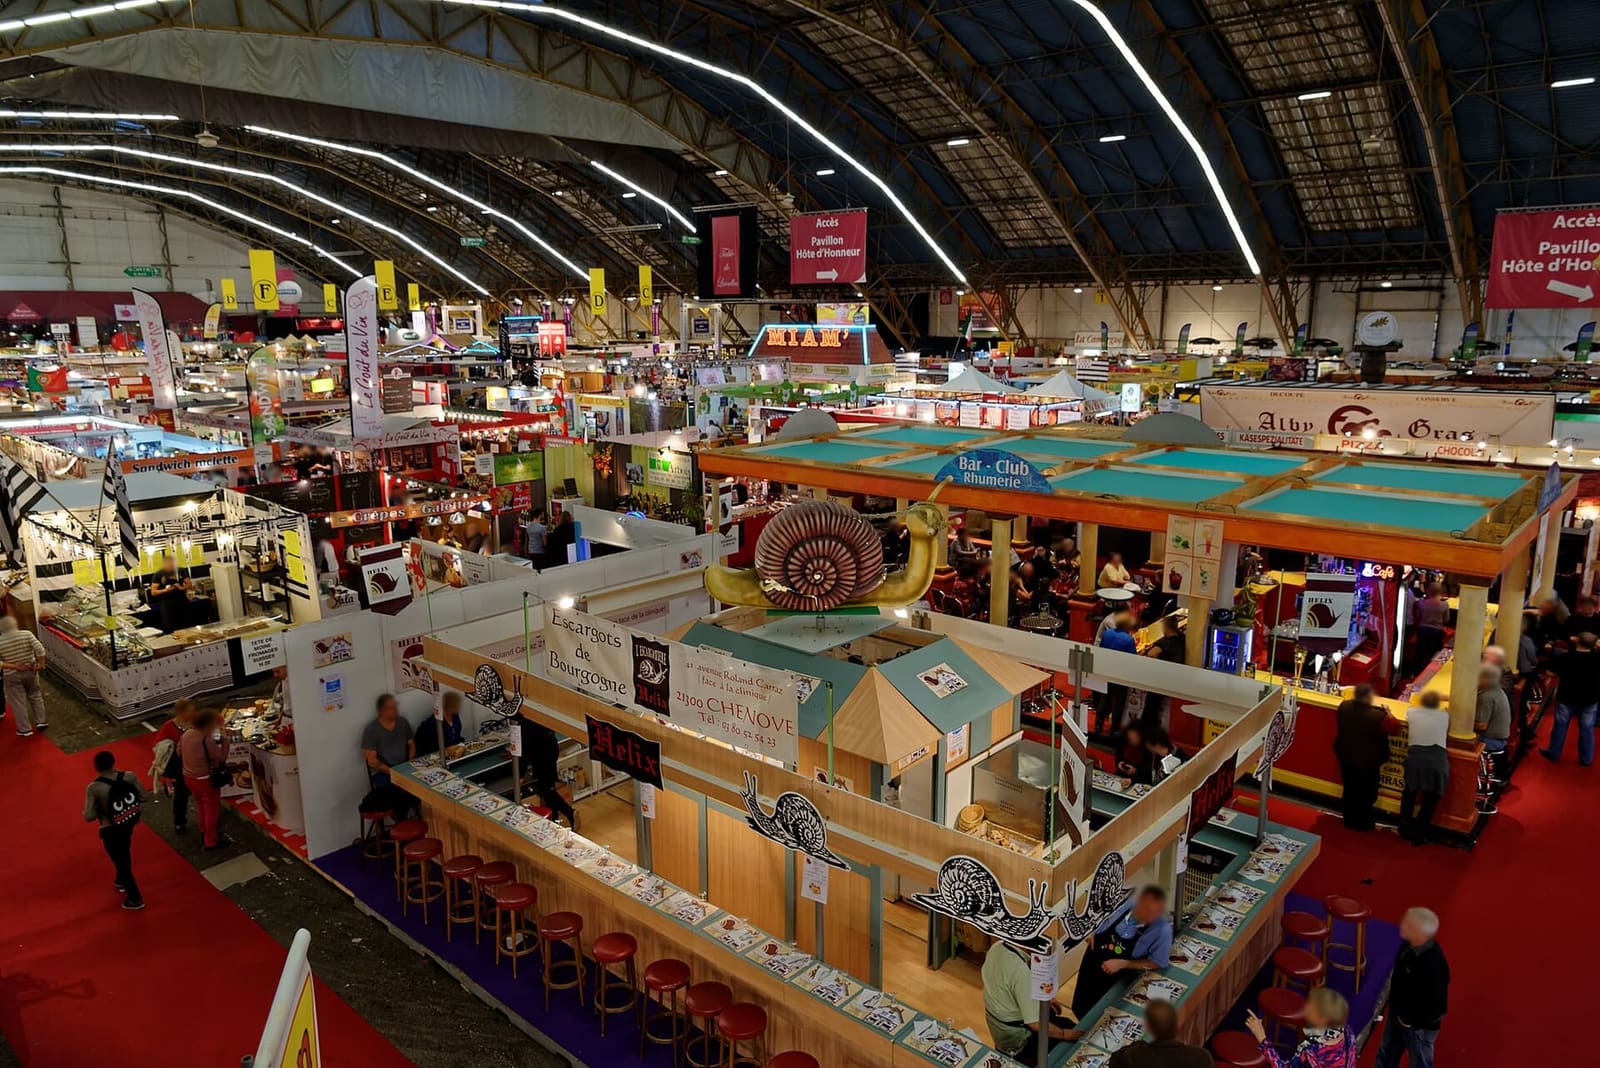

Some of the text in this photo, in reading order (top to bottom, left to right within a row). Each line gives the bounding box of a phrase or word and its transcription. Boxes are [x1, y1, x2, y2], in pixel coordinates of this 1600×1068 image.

[816, 217, 839, 228] Accès
[811, 235, 844, 246] Pavillon
[1538, 239, 1600, 255] Pavillo
[796, 248, 861, 259] Hôte d'Honneur
[1501, 259, 1544, 273] Hôte
[259, 283, 271, 299] F
[383, 288, 393, 301] E
[642, 288, 649, 299] C
[594, 295, 604, 306] D
[352, 315, 368, 338] Vin
[767, 328, 849, 347] MIAM'
[355, 338, 371, 357] du
[259, 356, 277, 436] SANDWICH
[1258, 411, 1476, 441] Alby Gras
[1341, 439, 1385, 450] PIZZA
[959, 456, 982, 471] Bar
[995, 459, 1030, 476] Club
[963, 471, 1022, 488] Rhumerie
[367, 566, 389, 576] HELIX
[552, 608, 622, 648] Escargots
[398, 636, 422, 648] HELI
[575, 643, 591, 662] de
[549, 650, 627, 695] Bourgogne
[697, 664, 722, 678] avenue
[723, 670, 754, 686] Roland
[756, 678, 784, 695] Carraz
[726, 683, 734, 693] la
[676, 690, 794, 736] 21300 CHENOVE
[698, 711, 715, 725] Tél
[722, 721, 730, 733] 03
[731, 722, 741, 735] 80
[767, 737, 776, 748] 23
[589, 720, 657, 777] Helix
